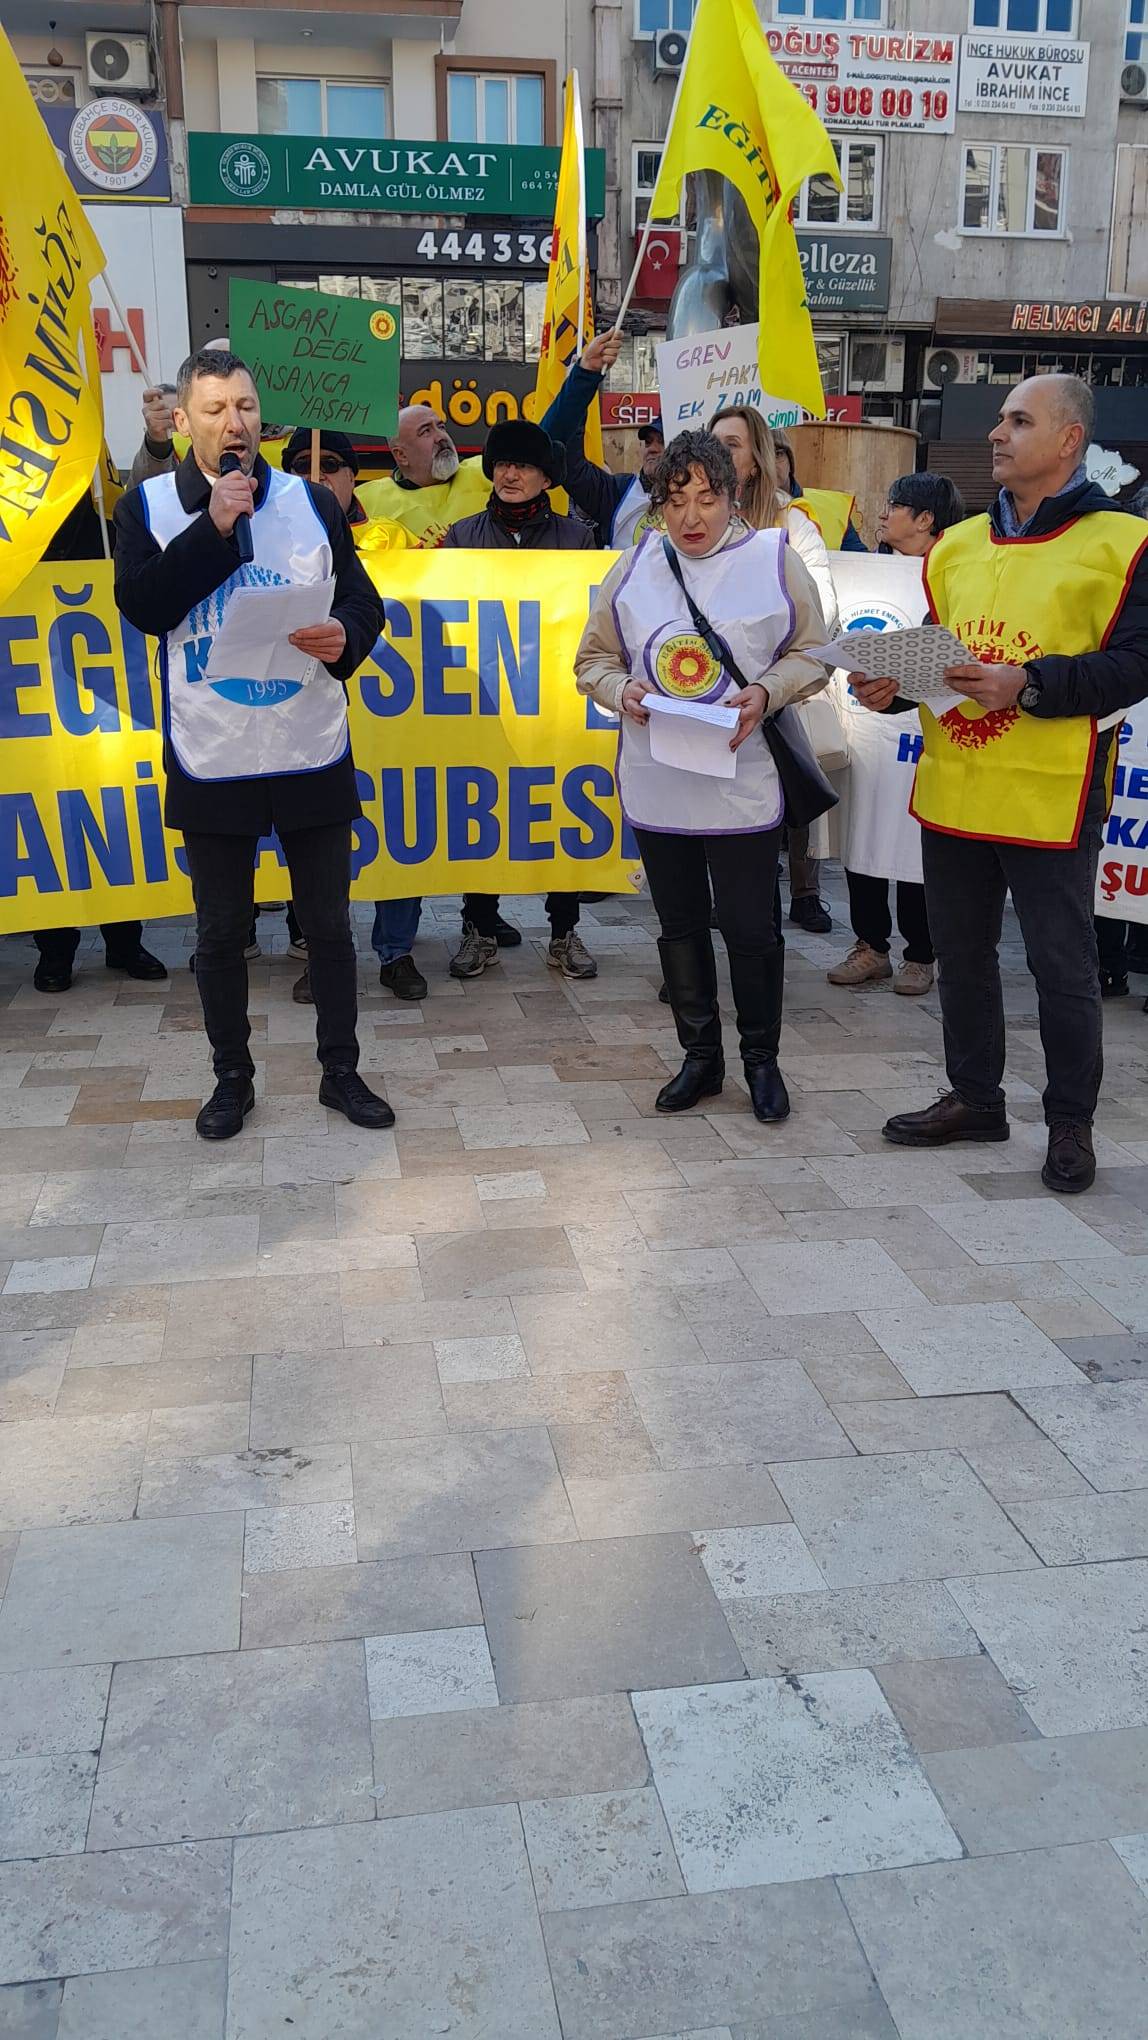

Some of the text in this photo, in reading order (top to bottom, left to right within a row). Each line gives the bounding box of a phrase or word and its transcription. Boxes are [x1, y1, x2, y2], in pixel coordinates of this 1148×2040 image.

[765, 26, 955, 63] OĞUŞ TURİZM
[967, 40, 993, 57] İNCE
[996, 44, 1036, 59] HUKUK
[791, 64, 837, 77] ACENTESİ
[987, 62, 1062, 81] AVUKAT
[826, 84, 874, 117] 908
[881, 87, 914, 119] 00
[922, 89, 949, 120] 10
[976, 78, 1071, 102] İBRAHİM İNCE
[73, 102, 108, 170] FENERBAHÇE
[111, 101, 142, 124] SPOR
[876, 119, 889, 128] TUR
[303, 147, 498, 177] AVUKAT
[534, 170, 558, 179] 0 54
[104, 175, 127, 186] 1907
[320, 182, 485, 201] DAMLA GÜL ÖLMEZ
[521, 181, 542, 190] 664
[797, 242, 878, 275] elleza
[816, 278, 825, 290] &
[828, 277, 877, 292] Güzellik
[248, 299, 342, 337] ASGARİ
[1011, 301, 1147, 334] HELVACI ALİ
[292, 336, 367, 364] DEĞİL
[676, 341, 732, 370] GREV
[706, 362, 760, 390] HAKT
[300, 393, 372, 425] YAŞAM
[678, 399, 705, 420] EK
[850, 608, 881, 618] HİZMET
[956, 614, 1046, 660] İTİM SE
[359, 597, 541, 718] SEN
[246, 680, 287, 700] 1995
